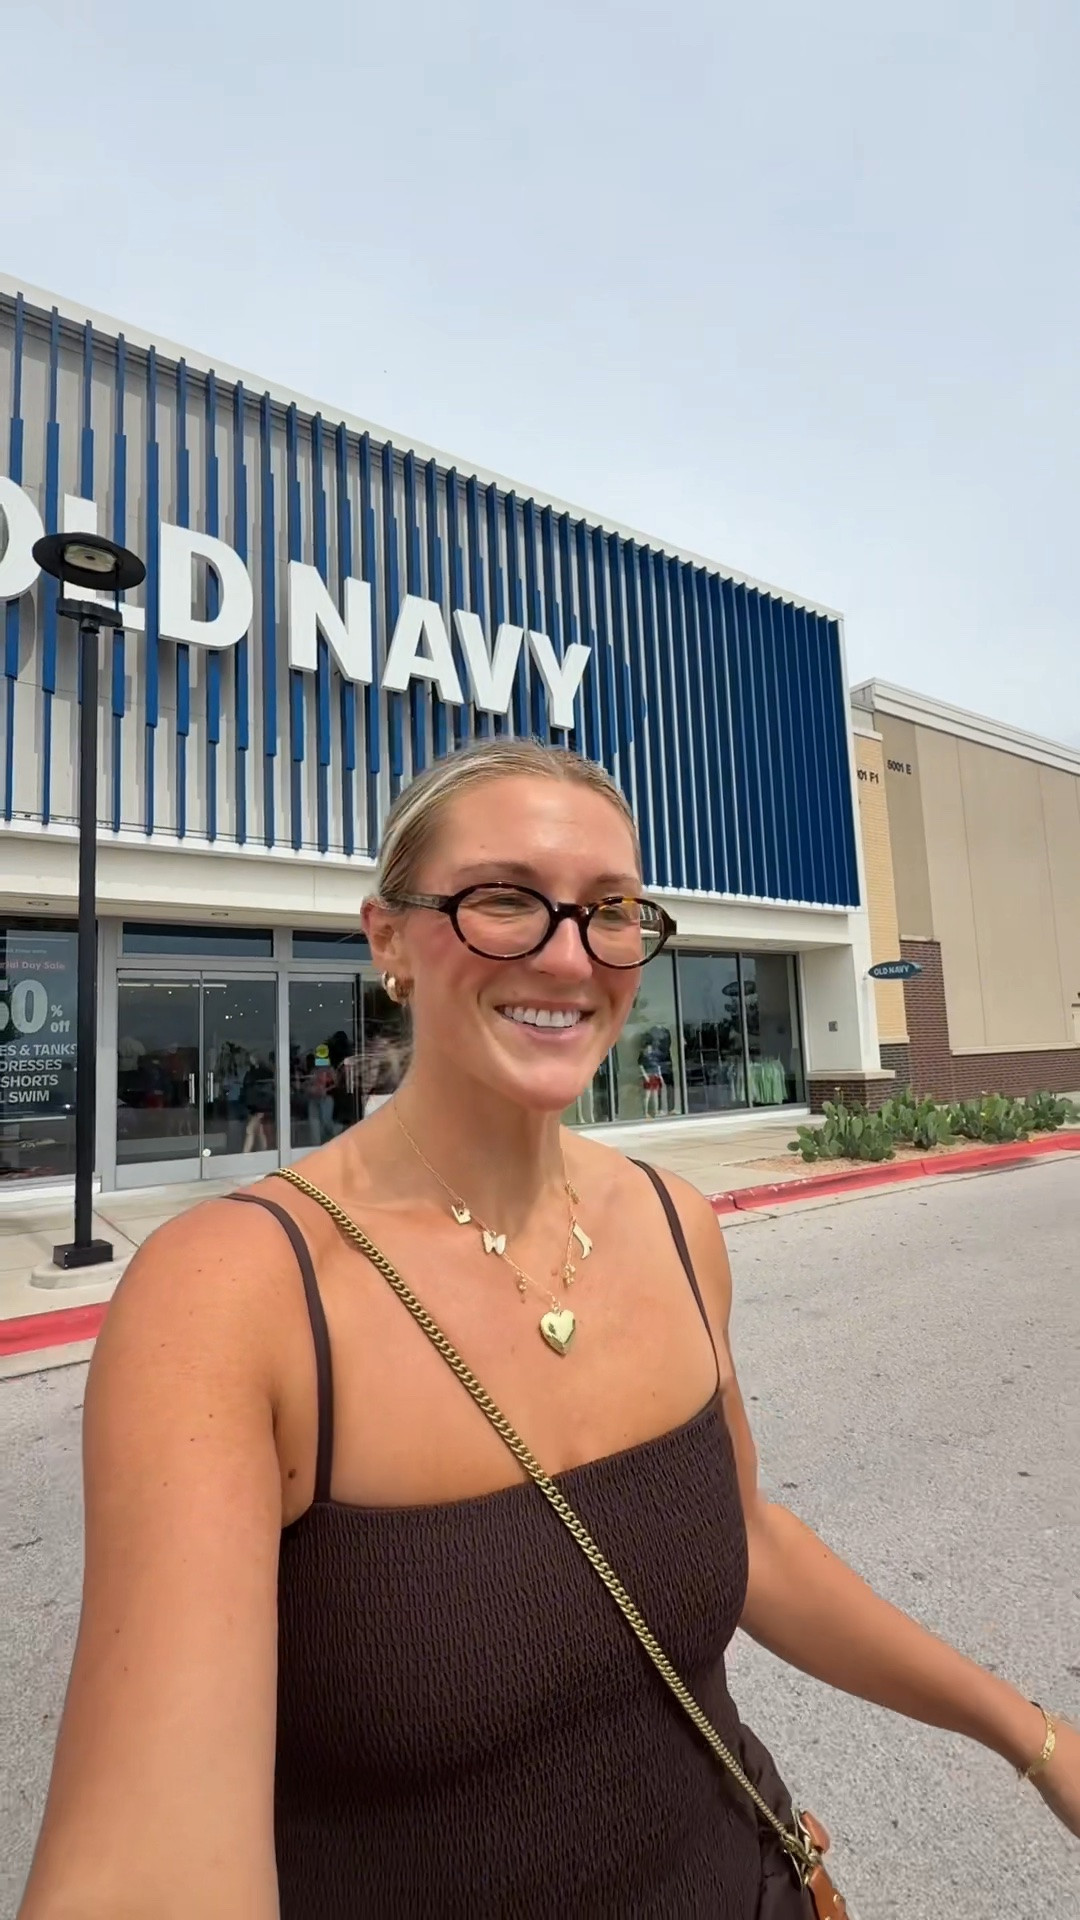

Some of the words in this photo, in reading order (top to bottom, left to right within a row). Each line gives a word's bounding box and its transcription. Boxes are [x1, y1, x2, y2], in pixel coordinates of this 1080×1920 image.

[287, 560, 592, 730] NAVY
[906, 763, 912, 775] E
[870, 771, 879, 784] F1
[22, 961, 42, 971] Day
[44, 961, 66, 970] Sale
[873, 967, 888, 976] OLD
[888, 964, 910, 975] NAVY
[0, 979, 48, 1034] 0
[50, 1004, 63, 1018] %
[50, 1020, 70, 1033] off
[19, 1044, 30, 1056] &
[33, 1043, 77, 1056] TANKS
[0, 1074, 59, 1088] SHORTS
[8, 1090, 50, 1104] SWIM
